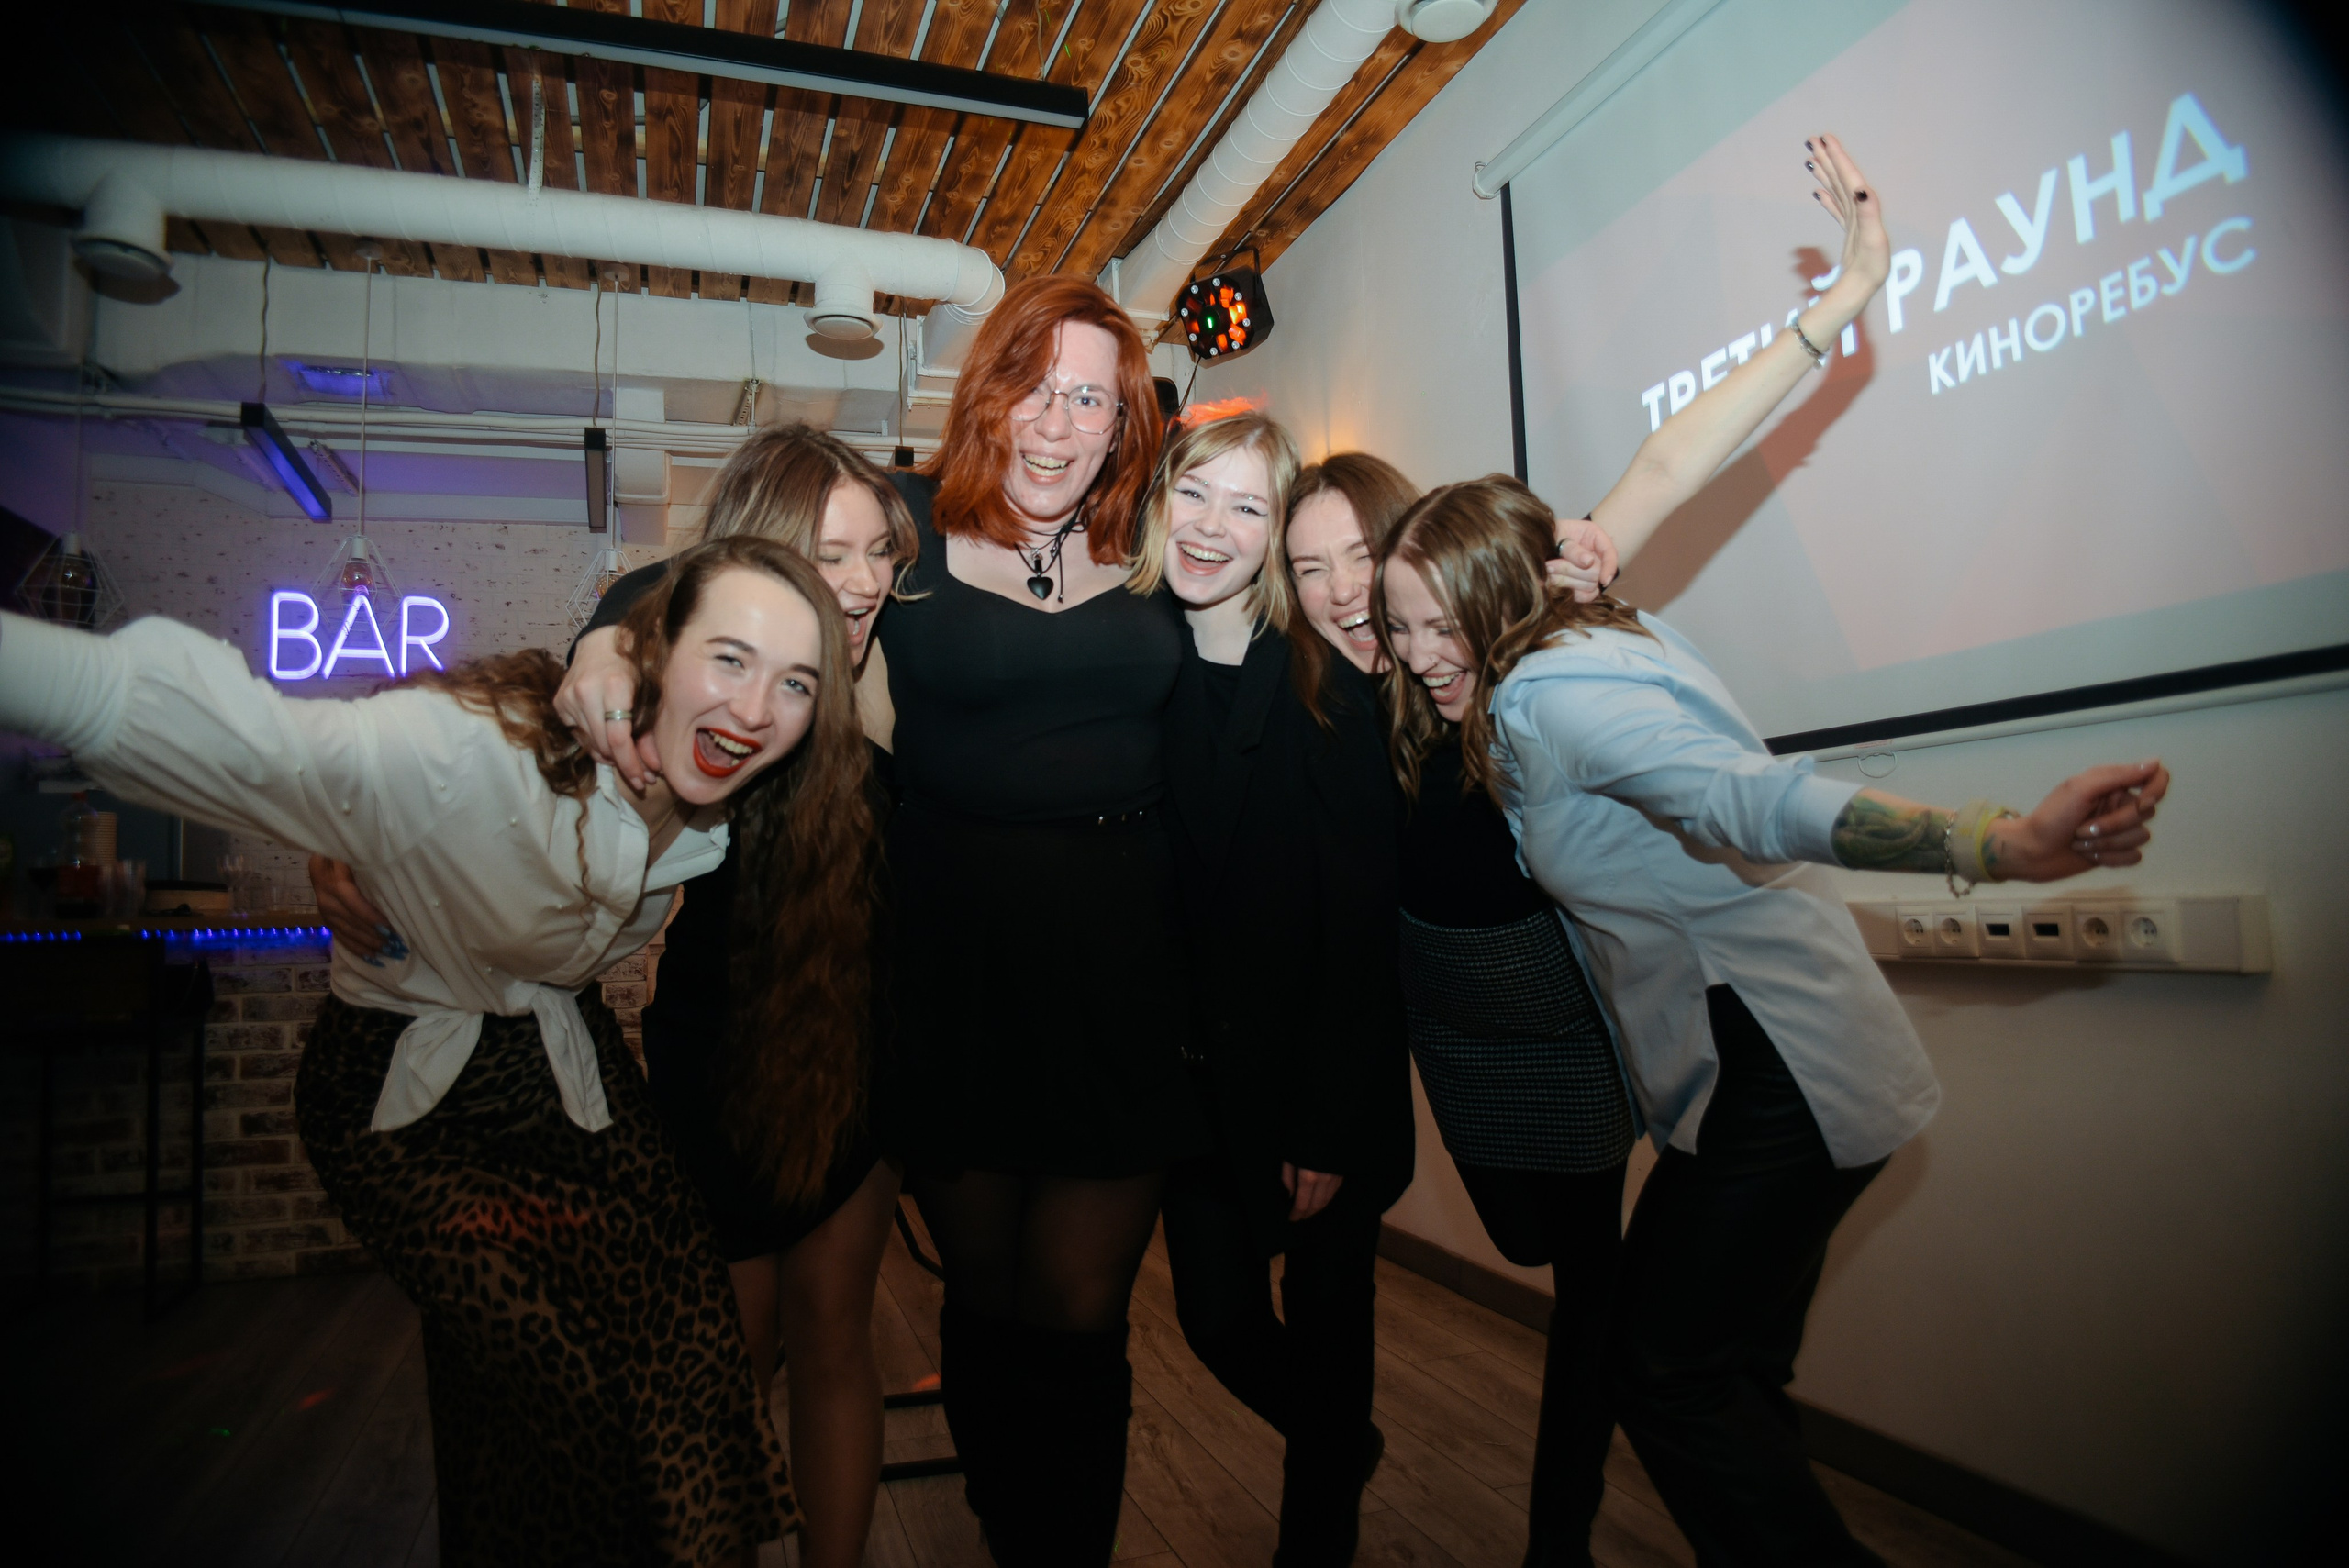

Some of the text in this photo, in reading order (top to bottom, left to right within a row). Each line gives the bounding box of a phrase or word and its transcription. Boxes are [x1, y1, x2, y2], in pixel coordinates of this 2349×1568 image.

[1885, 93, 2248, 334] РАУНД
[1928, 216, 2258, 395] КИНОРЕБУС
[270, 591, 450, 680] BAR
